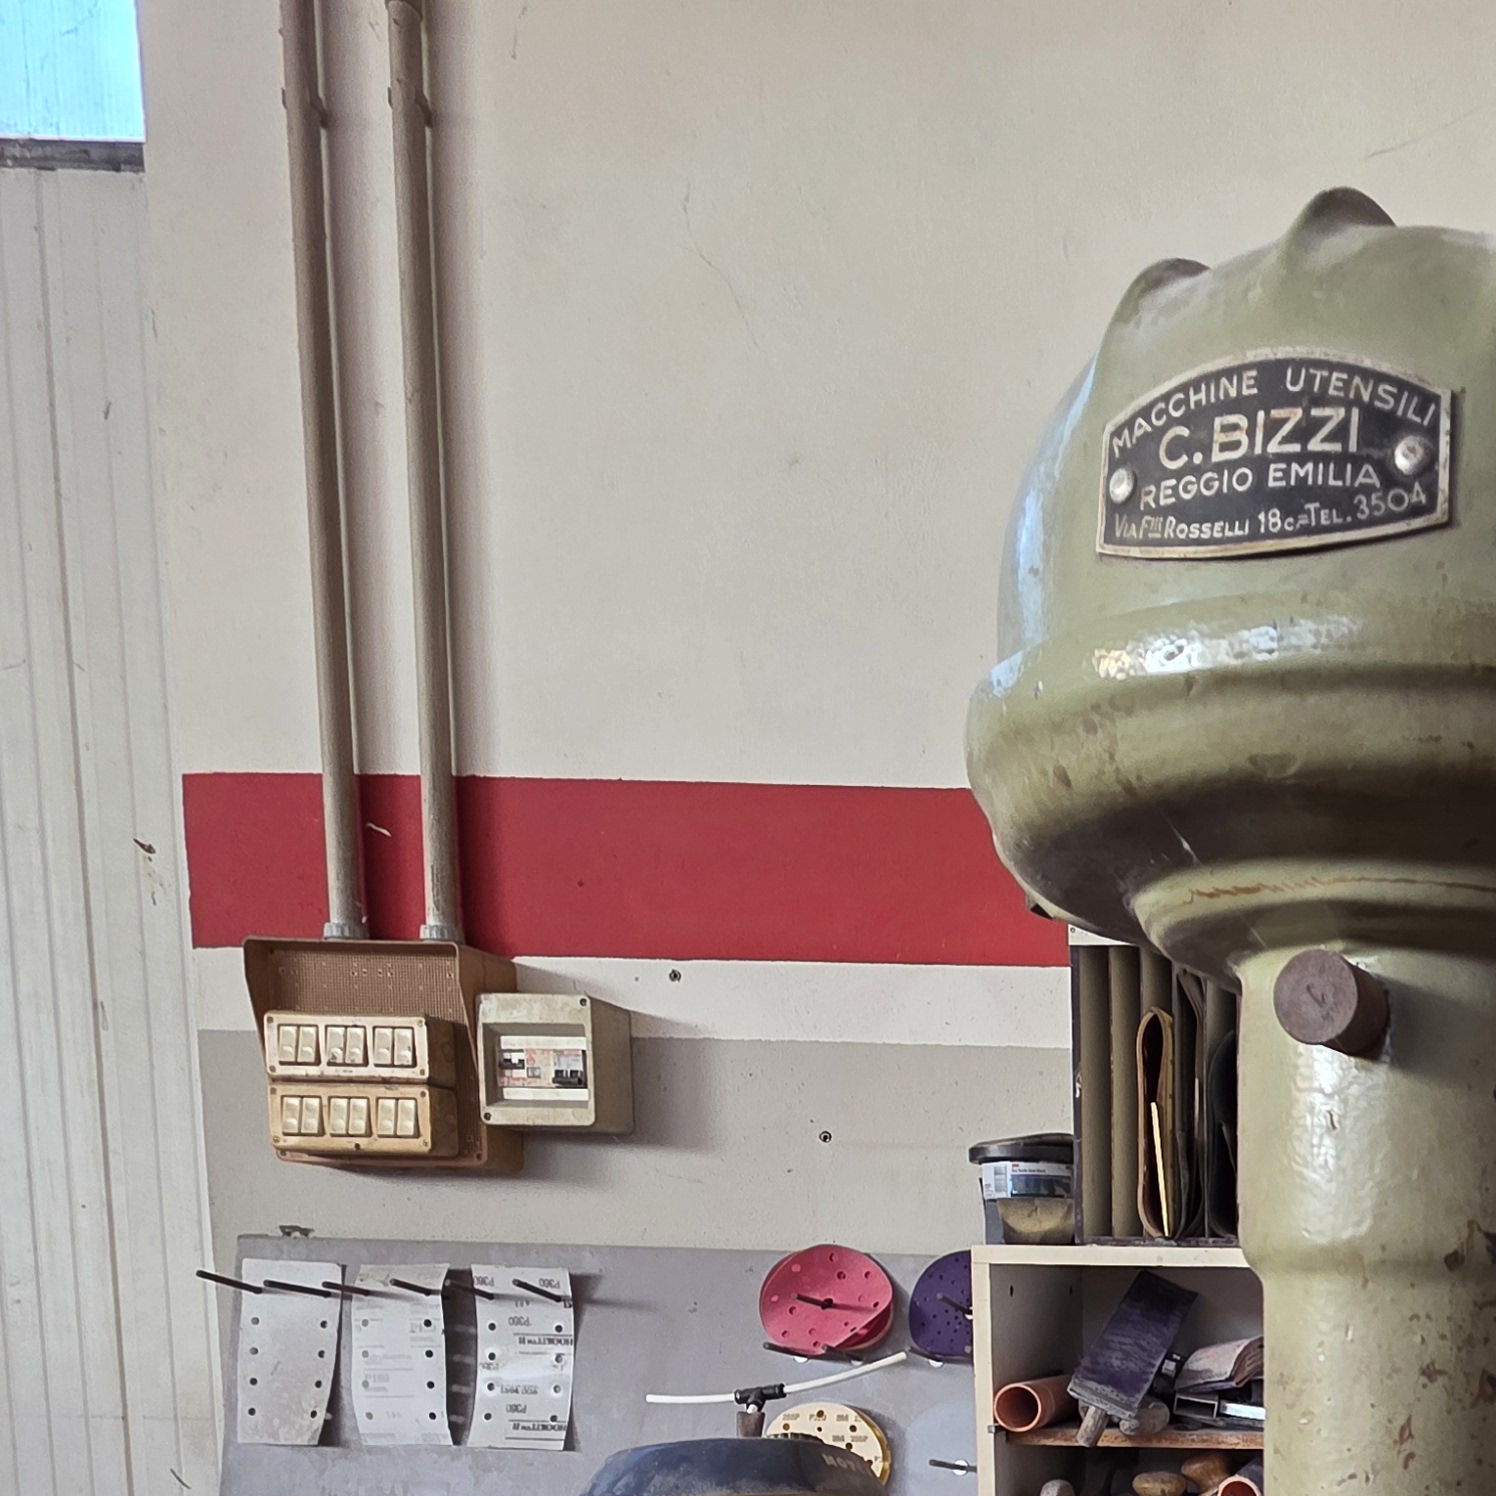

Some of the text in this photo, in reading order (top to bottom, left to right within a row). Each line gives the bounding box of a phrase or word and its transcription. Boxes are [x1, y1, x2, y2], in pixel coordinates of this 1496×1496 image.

[1112, 367, 1436, 458] MACCHINE UTENSILI
[1158, 405, 1360, 470] C.BIZZI
[1139, 462, 1381, 511] REGGIO EMILIA
[1164, 515, 1250, 540] ROSSELLI
